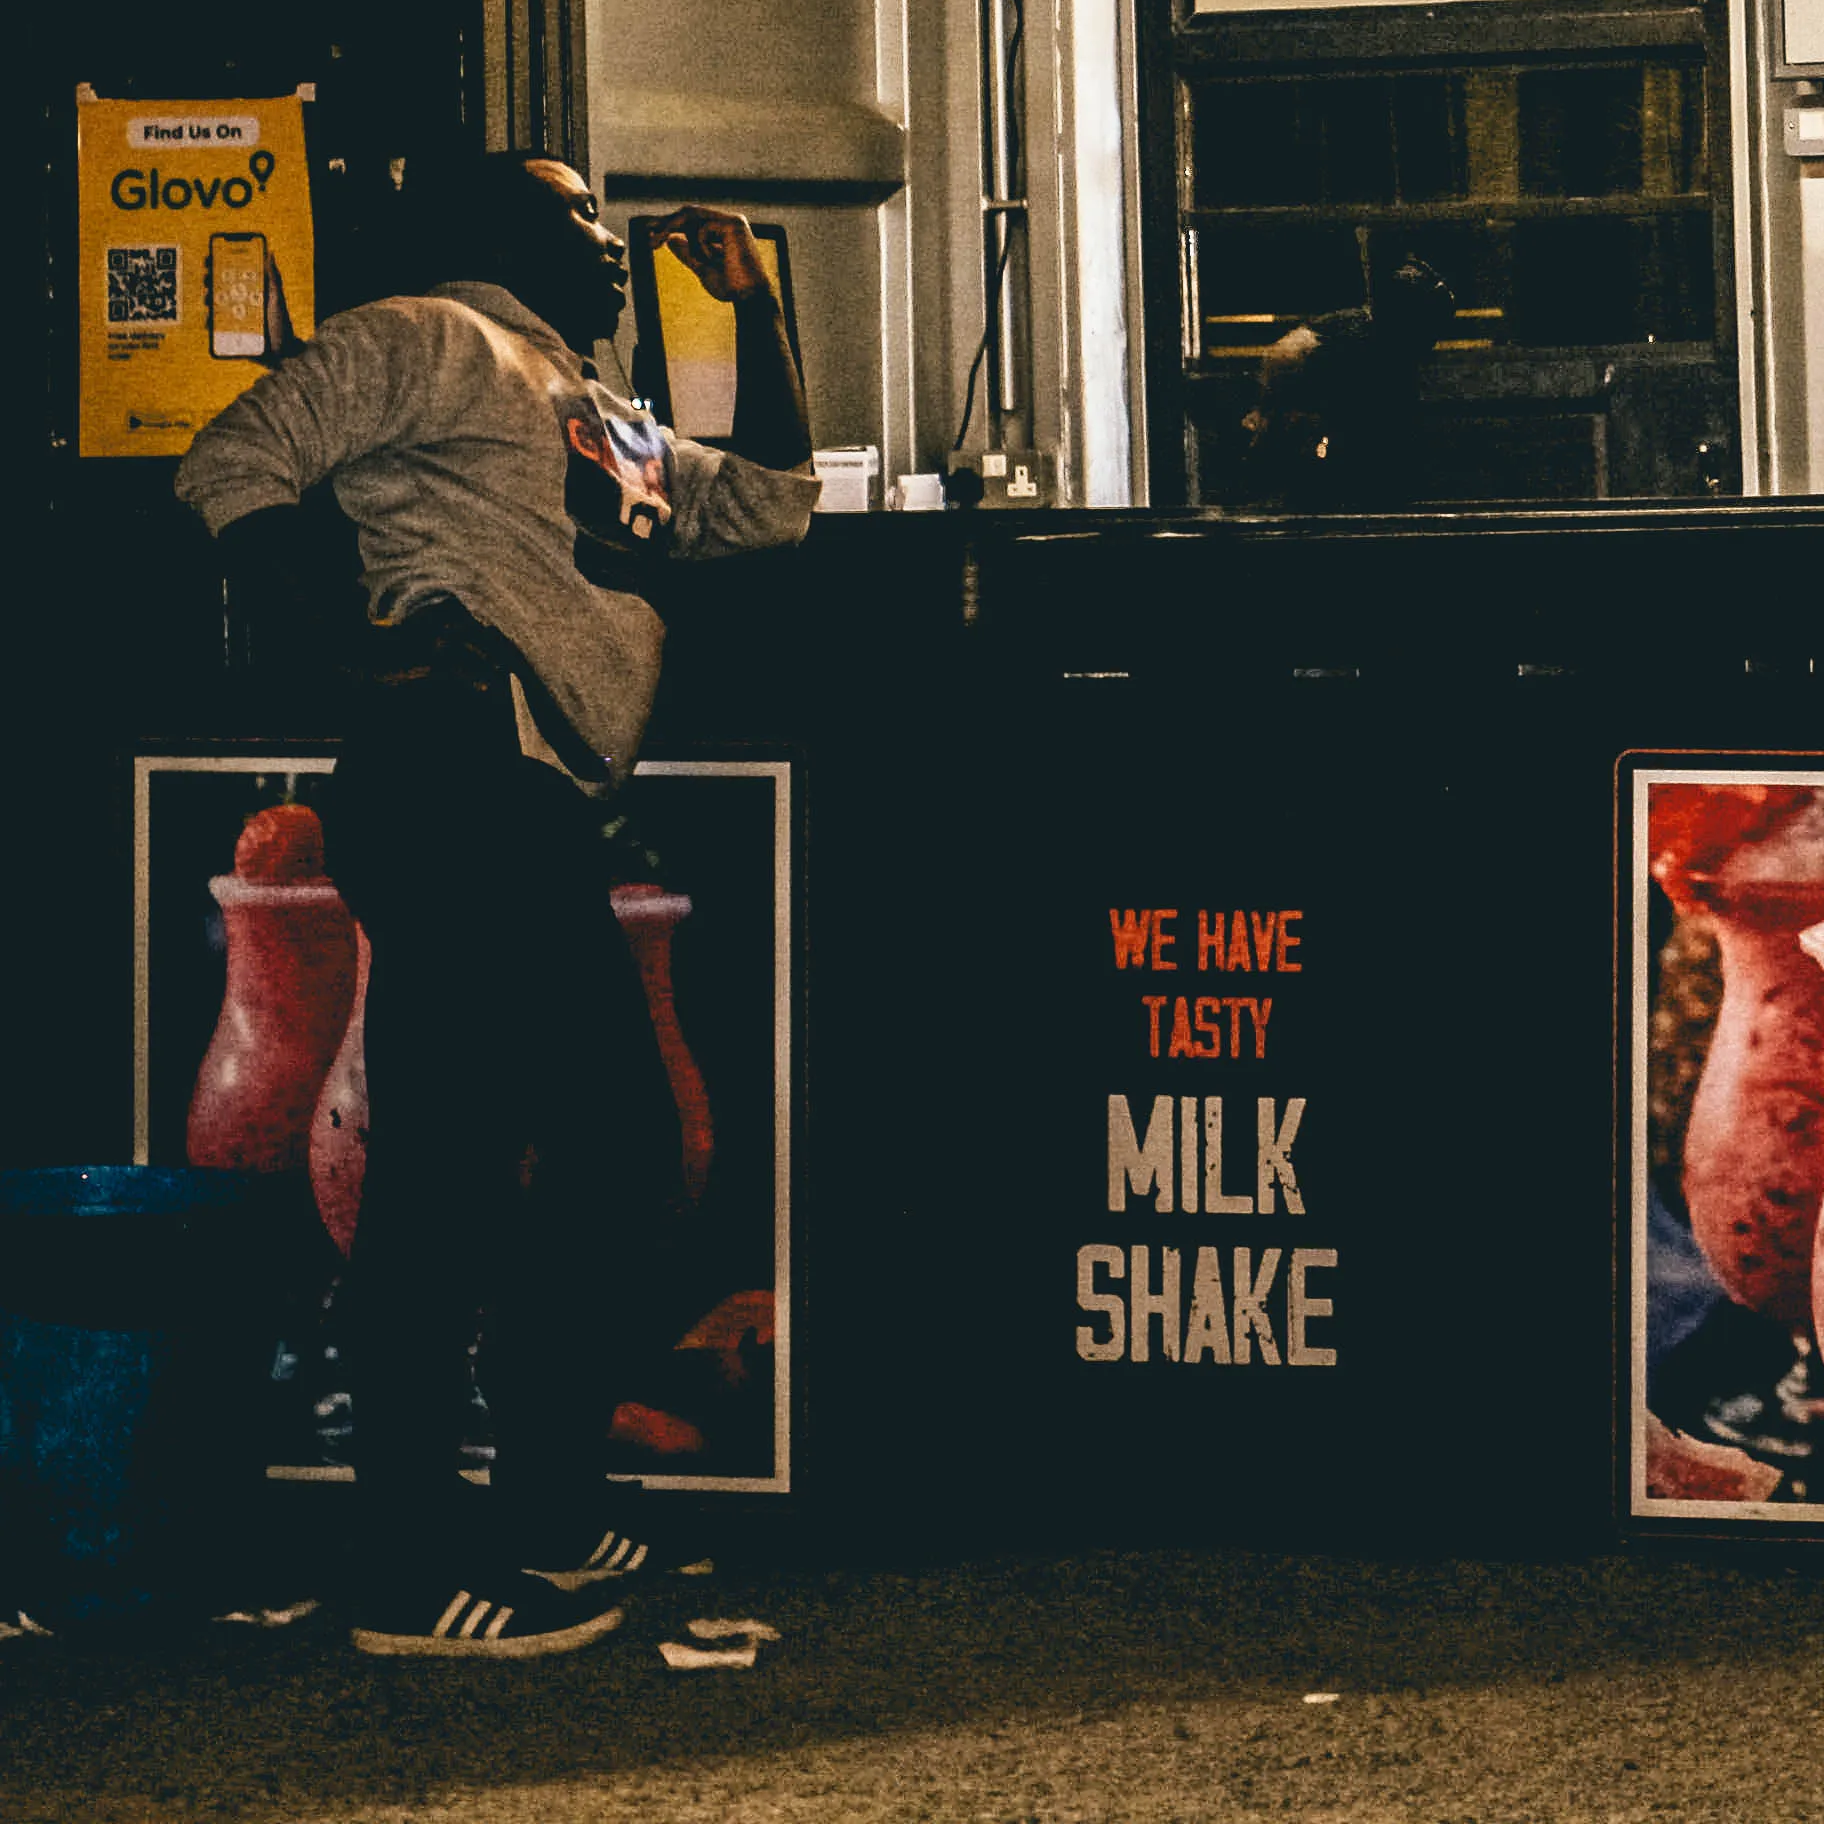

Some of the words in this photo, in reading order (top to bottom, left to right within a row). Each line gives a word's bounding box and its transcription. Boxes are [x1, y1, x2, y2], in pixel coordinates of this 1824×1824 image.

[143, 124, 184, 139] Find
[188, 124, 211, 139] Us
[216, 124, 242, 139] On
[110, 167, 254, 210] Glovo
[1109, 908, 1178, 970] WE
[1198, 909, 1304, 972] HAVE
[1141, 995, 1273, 1059] TASTY
[1107, 1093, 1307, 1215] MILK
[1075, 1243, 1338, 1366] SHAKE
